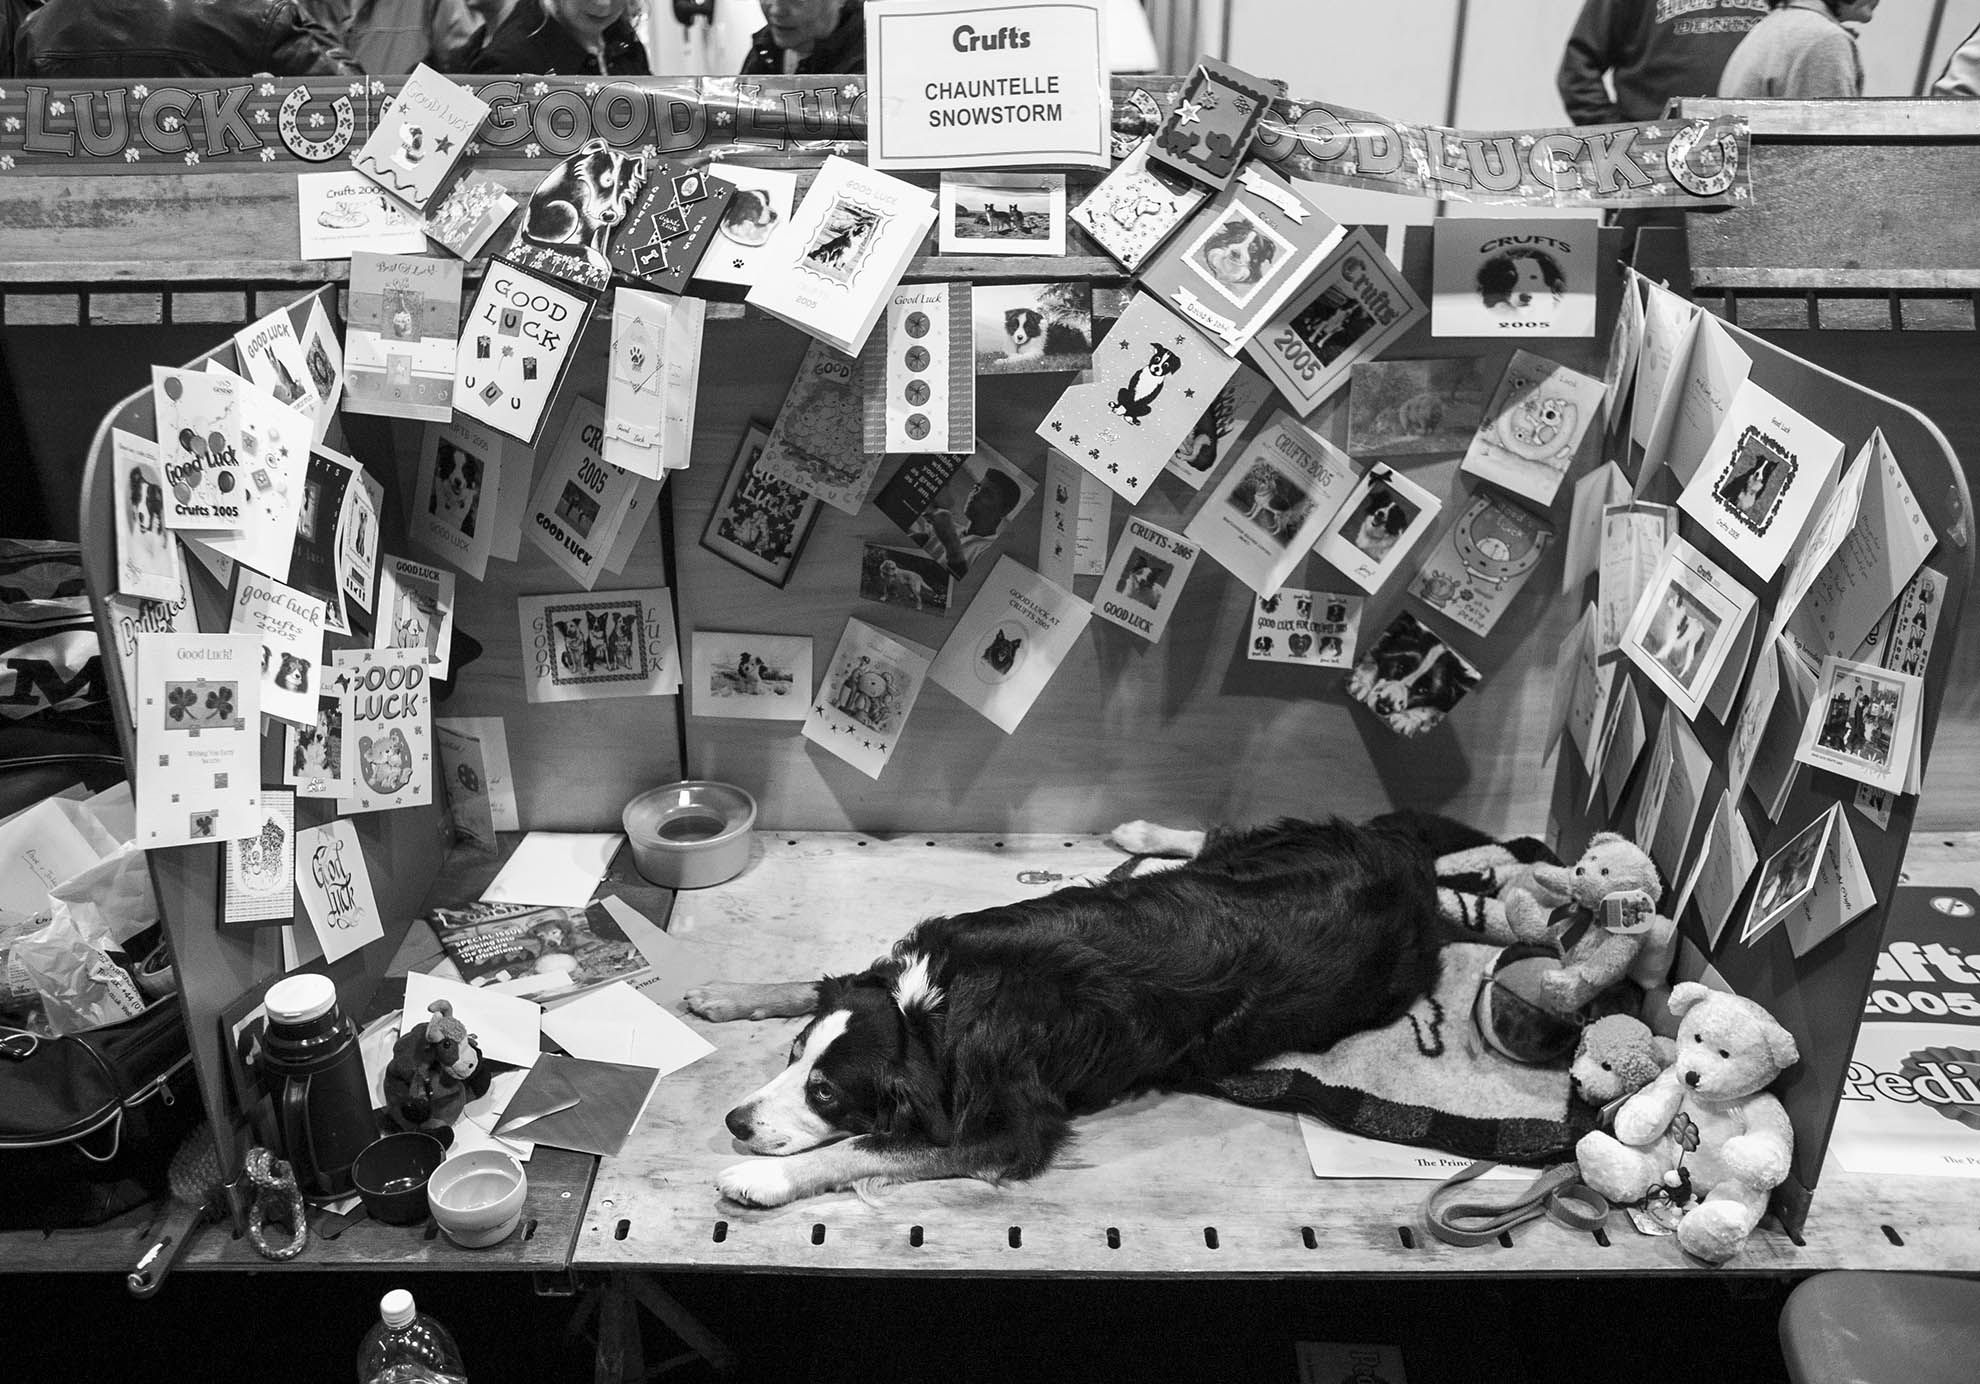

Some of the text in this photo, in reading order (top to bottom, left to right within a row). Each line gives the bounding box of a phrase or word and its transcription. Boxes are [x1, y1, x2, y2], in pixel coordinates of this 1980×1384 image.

[953, 25, 1031, 52] Crufts
[925, 76, 1060, 100] CHAUNTELLE
[24, 84, 264, 157] LUCK
[475, 81, 707, 154] GOOD
[928, 104, 1063, 128] SNOWSTORM
[1421, 127, 1654, 195] LUCK
[326, 185, 356, 199] Crufts
[683, 216, 707, 250] 2005
[1480, 234, 1573, 255] CRUFTS
[495, 279, 568, 323] GOOD
[894, 292, 943, 305] Good Luck
[1341, 256, 1399, 326] Crufts
[247, 322, 291, 359] GOOD LUCK
[483, 303, 561, 352] LUCK
[1498, 321, 1551, 330] 2005
[814, 362, 849, 378] GOOD
[1274, 329, 1322, 381] 2005
[165, 445, 240, 488] Good Luck
[577, 457, 609, 494] 2005
[1274, 433, 1335, 488] CRUFTS 2005
[175, 504, 239, 517] Crufts 2005
[536, 511, 594, 566] GOOD LUCK
[1130, 521, 1167, 549] CRUFTS
[1171, 542, 1194, 561] 2005
[396, 561, 441, 582] GOOD LUCK
[240, 585, 321, 628] good luck
[1009, 588, 1031, 605] GOOD
[1029, 602, 1050, 619] LUCK
[1009, 599, 1036, 621] CRUFTS
[1103, 601, 1154, 634] GOOD LUCK
[253, 611, 304, 634] crufts
[255, 621, 298, 641] 2005
[177, 647, 233, 661] Good Luck!
[533, 616, 551, 678] GOOD
[645, 607, 664, 673] LUCK
[353, 692, 419, 722] LUCK
[454, 927, 523, 949] SPECIAL ISSUE
[458, 936, 515, 956] Looking into
[460, 942, 508, 960] the Future
[463, 945, 524, 964] of Obedience
[1415, 1158, 1437, 1168] The
